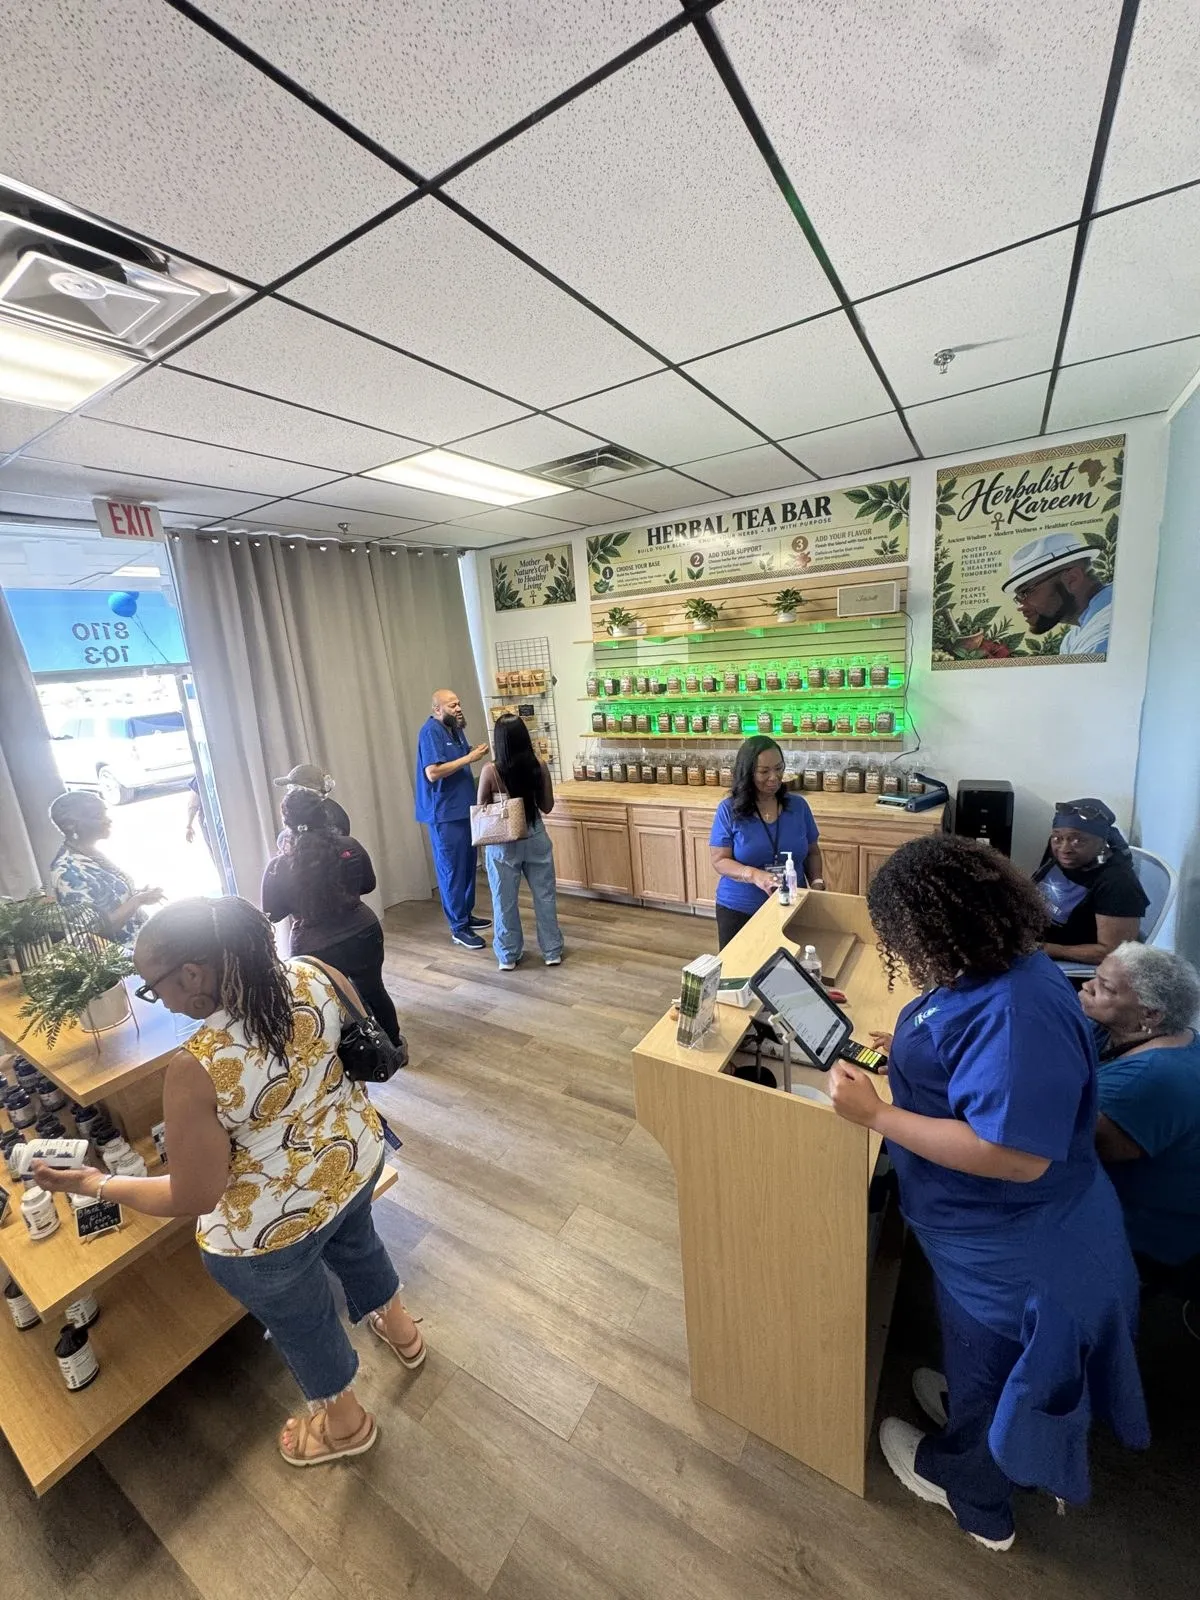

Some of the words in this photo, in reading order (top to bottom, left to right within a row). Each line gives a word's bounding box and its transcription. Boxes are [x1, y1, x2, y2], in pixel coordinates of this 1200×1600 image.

[957, 462, 1077, 521] Herbalist
[1007, 491, 1100, 524] Kareem
[107, 502, 154, 537] EXIT
[647, 514, 729, 546] HERBAL
[733, 506, 776, 531] TEA
[781, 495, 832, 524] BAR
[800, 518, 832, 527] PURPOSE
[829, 532, 846, 541] YOUR
[847, 528, 872, 538] FLAVOR
[796, 538, 804, 551] 3
[721, 549, 736, 557] YOUR
[736, 545, 762, 554] SUPPORT
[970, 550, 1002, 558] HERITAGE
[520, 557, 540, 567] Mother
[693, 555, 701, 565] 2
[514, 567, 538, 577] Nature's
[538, 564, 549, 572] Gift
[616, 564, 634, 572] CHOOSE
[635, 562, 647, 570] YOUR
[966, 562, 1002, 571] HEALTHIER
[524, 573, 546, 583] Healthy
[961, 569, 998, 578] TOMORROW
[523, 582, 542, 591] Living
[960, 598, 989, 606] PURPOSE
